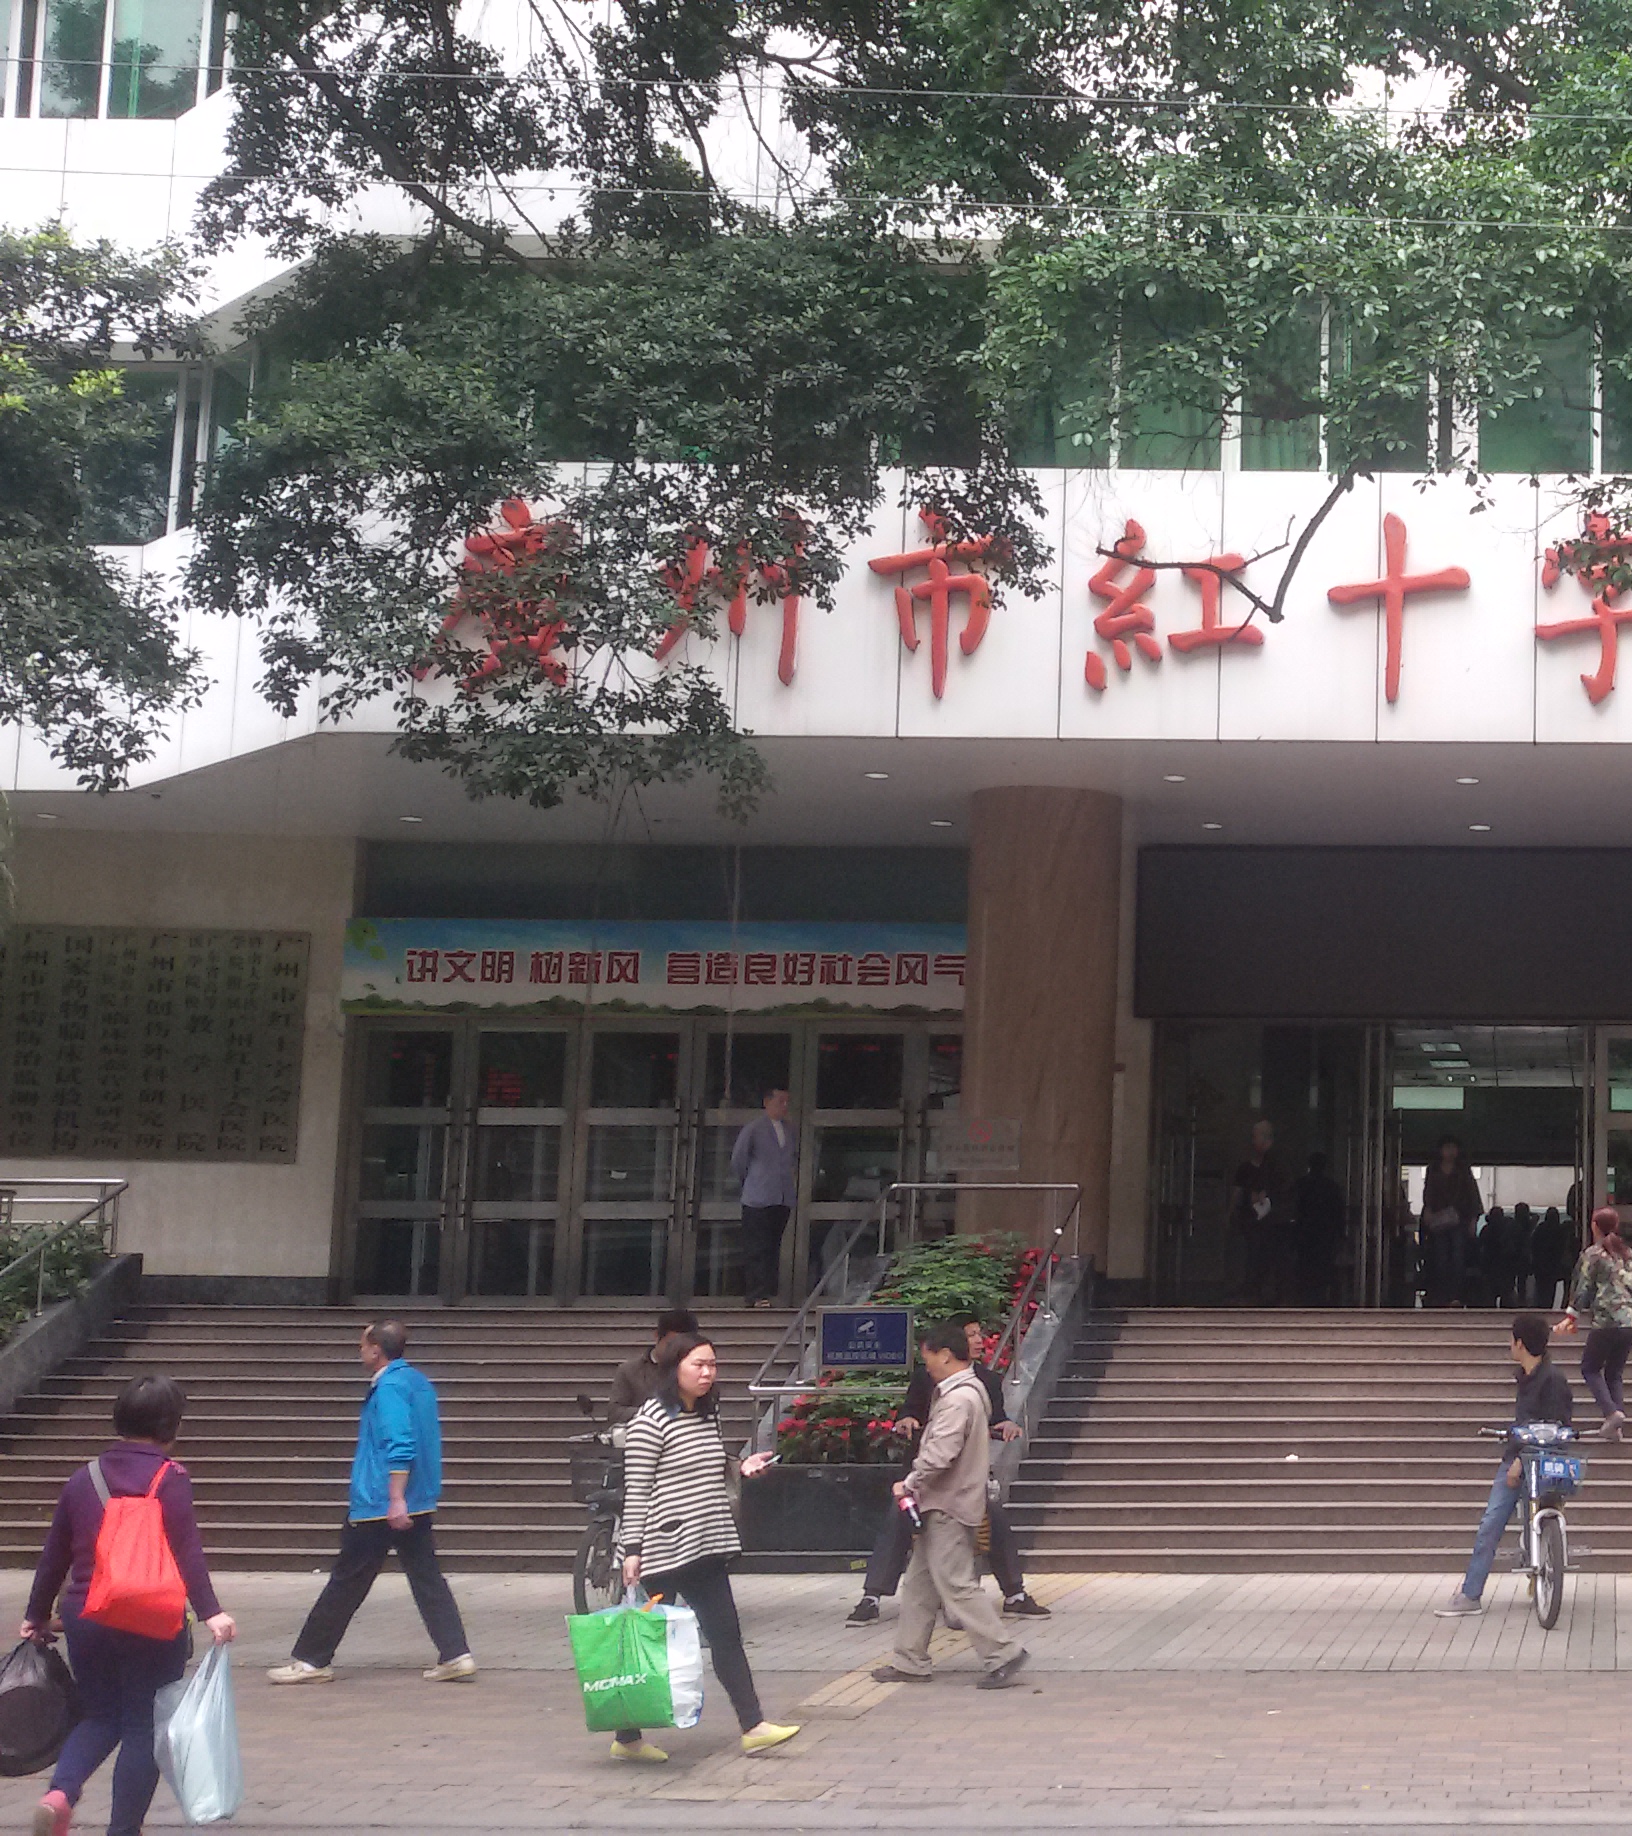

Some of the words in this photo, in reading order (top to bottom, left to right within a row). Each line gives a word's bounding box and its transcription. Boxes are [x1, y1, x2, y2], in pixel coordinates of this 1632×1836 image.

[404, 949, 515, 985] 讲文明
[529, 949, 640, 986] 树新风
[667, 951, 966, 987] 营造良好社会风气
